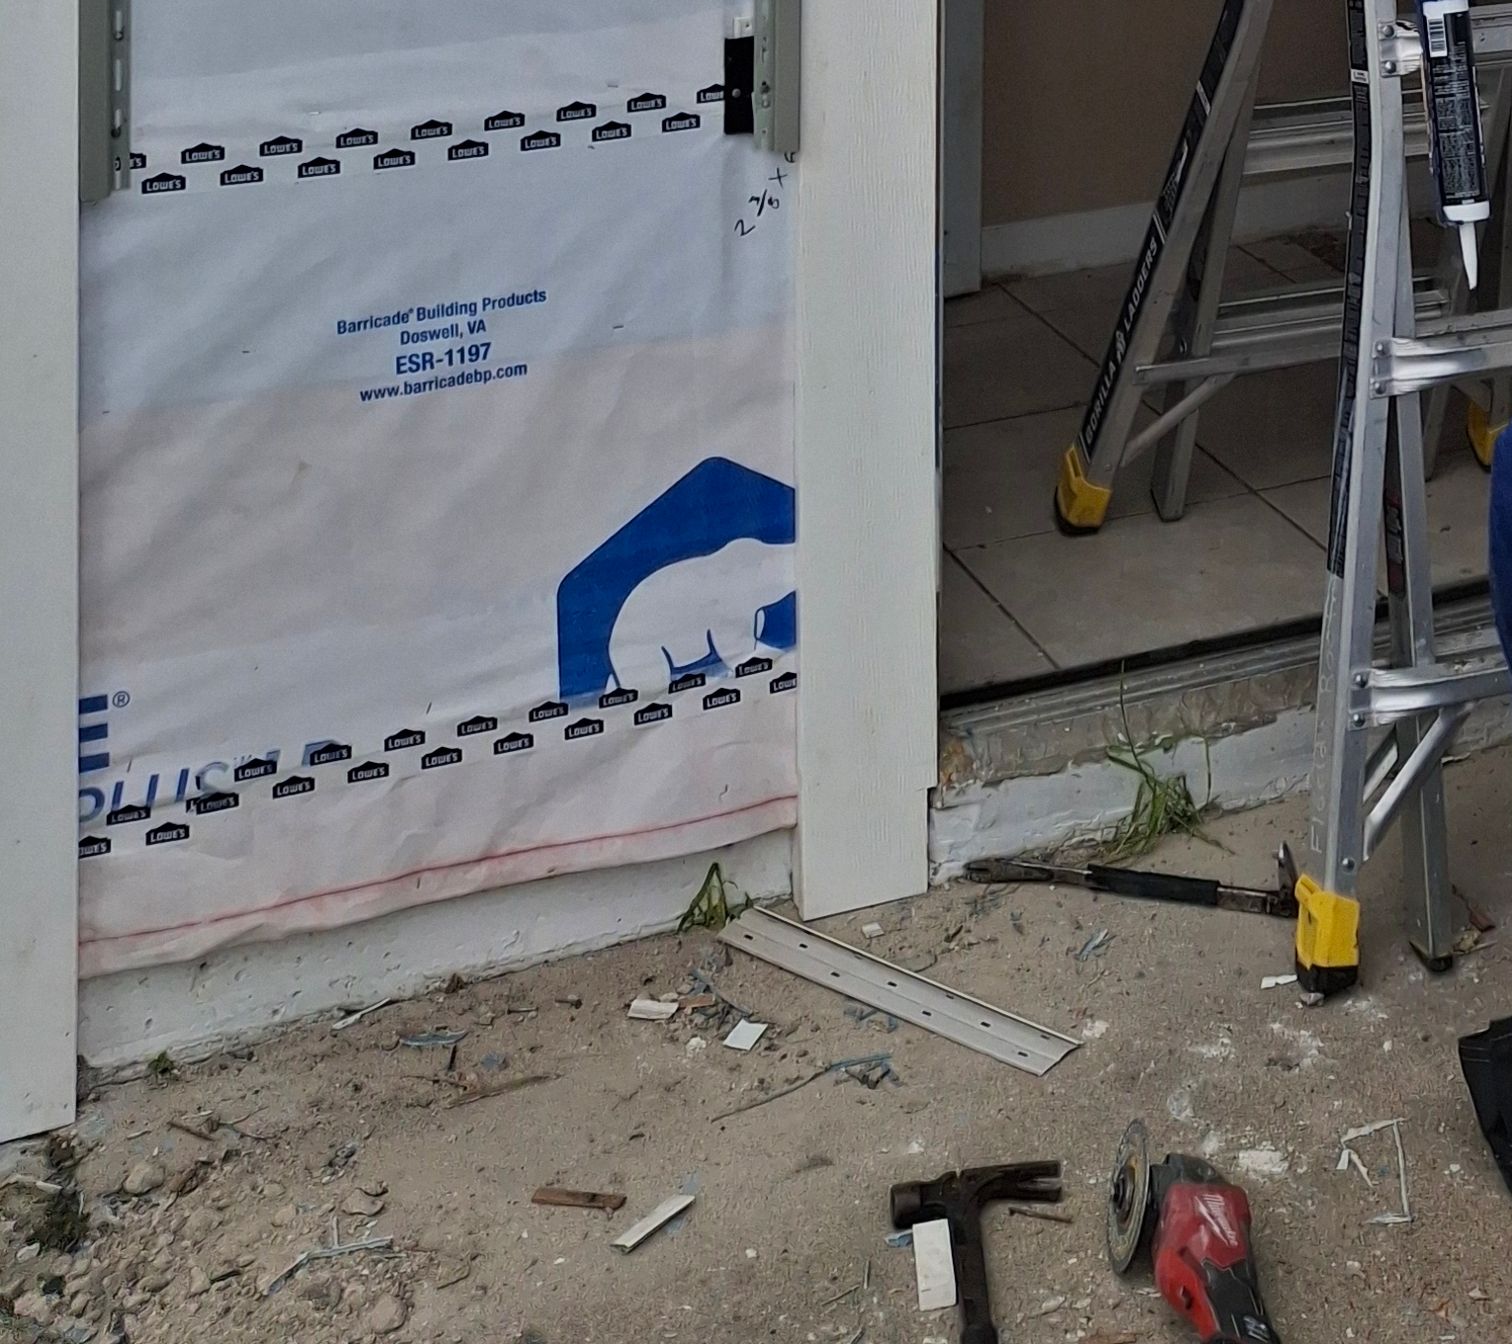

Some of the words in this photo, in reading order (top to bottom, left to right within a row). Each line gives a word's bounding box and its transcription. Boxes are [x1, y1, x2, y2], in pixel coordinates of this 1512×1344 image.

[1124, 236, 1158, 331] LADDERS
[416, 301, 477, 322] Building
[482, 289, 547, 312] Products
[400, 323, 463, 346] Doswell,
[467, 319, 487, 335] VA
[395, 342, 492, 375] ESR-1197
[360, 363, 528, 402] www.barricadebp.com
